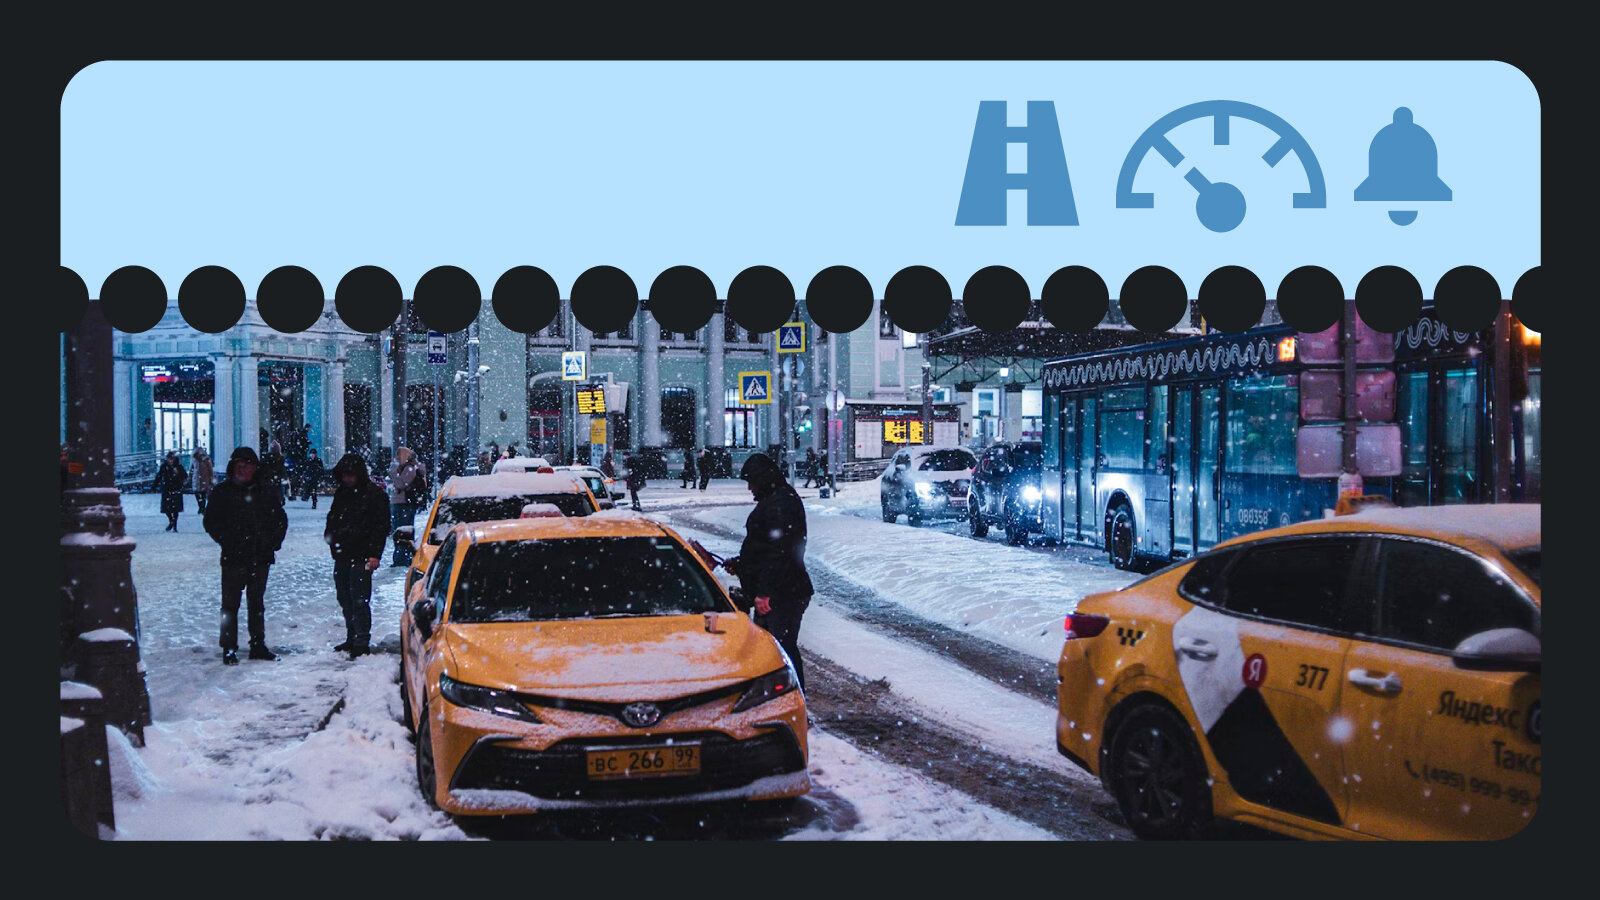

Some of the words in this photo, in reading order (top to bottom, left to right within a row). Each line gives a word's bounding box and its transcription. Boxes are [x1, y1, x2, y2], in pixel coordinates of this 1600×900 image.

[1248, 658, 1263, 681] Я
[1296, 664, 1330, 691] 377
[1437, 690, 1522, 730] Яндекс
[629, 751, 665, 770] 266
[675, 748, 693, 762] 99
